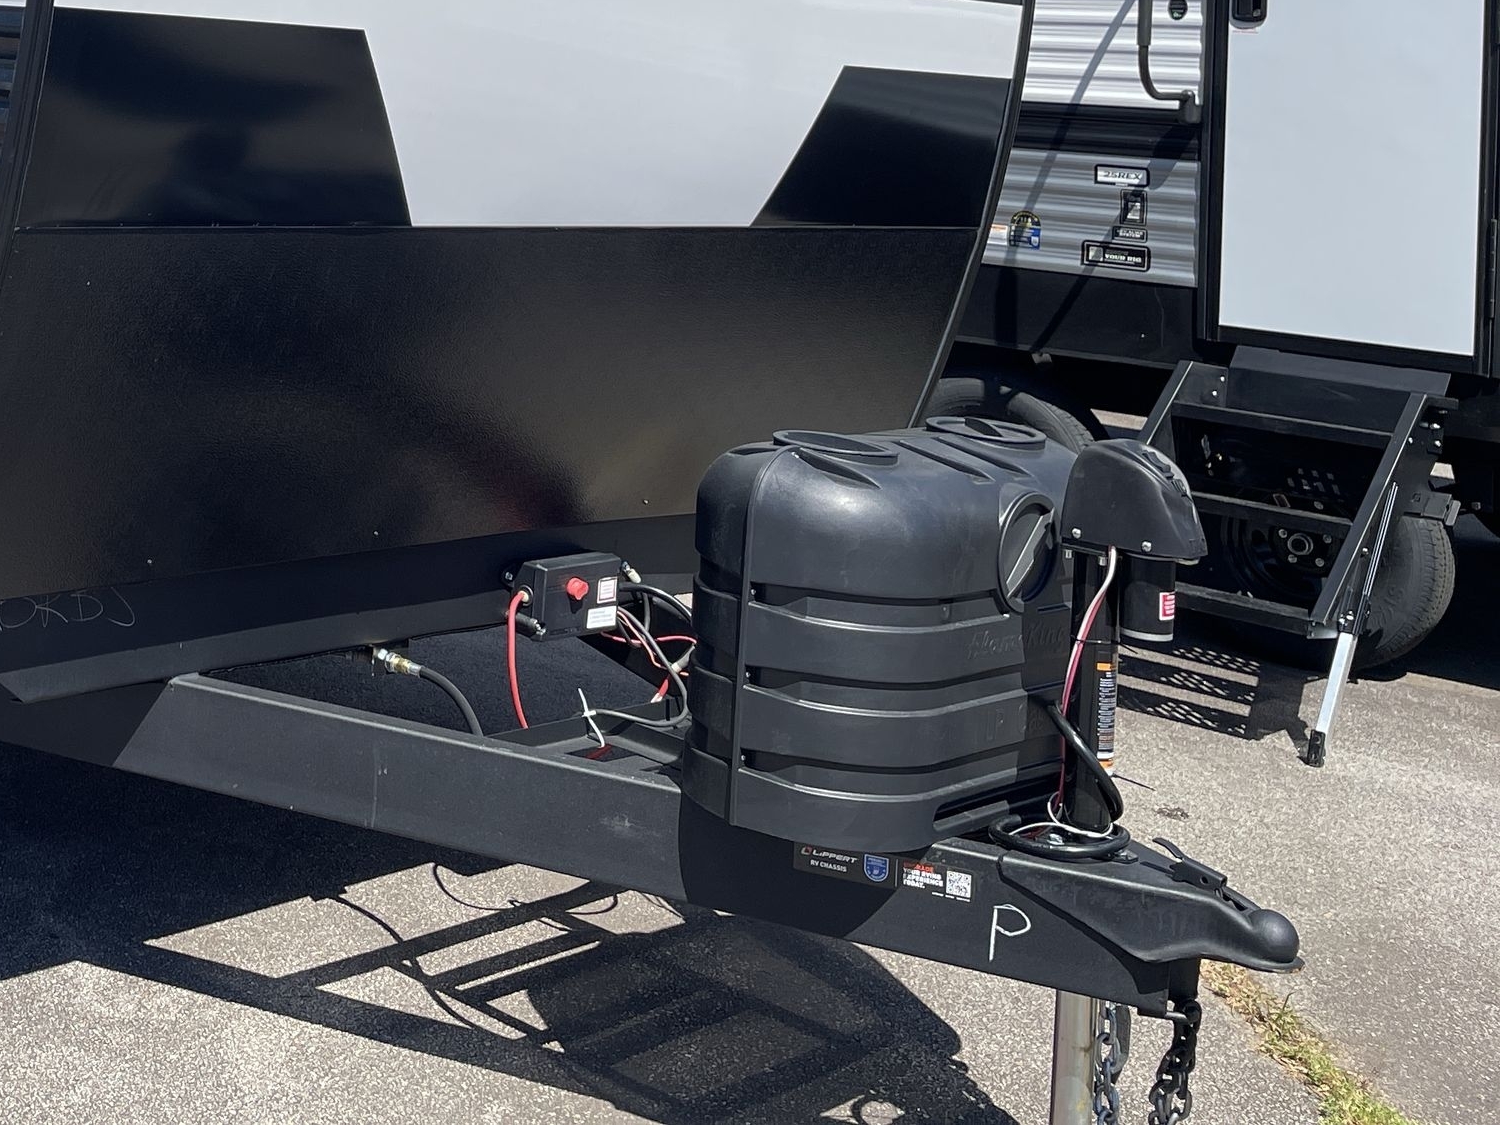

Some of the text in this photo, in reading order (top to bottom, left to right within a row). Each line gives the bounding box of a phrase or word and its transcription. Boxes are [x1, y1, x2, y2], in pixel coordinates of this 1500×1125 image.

[810, 858, 848, 873] RV CHASSIS
[988, 903, 1032, 963] P
